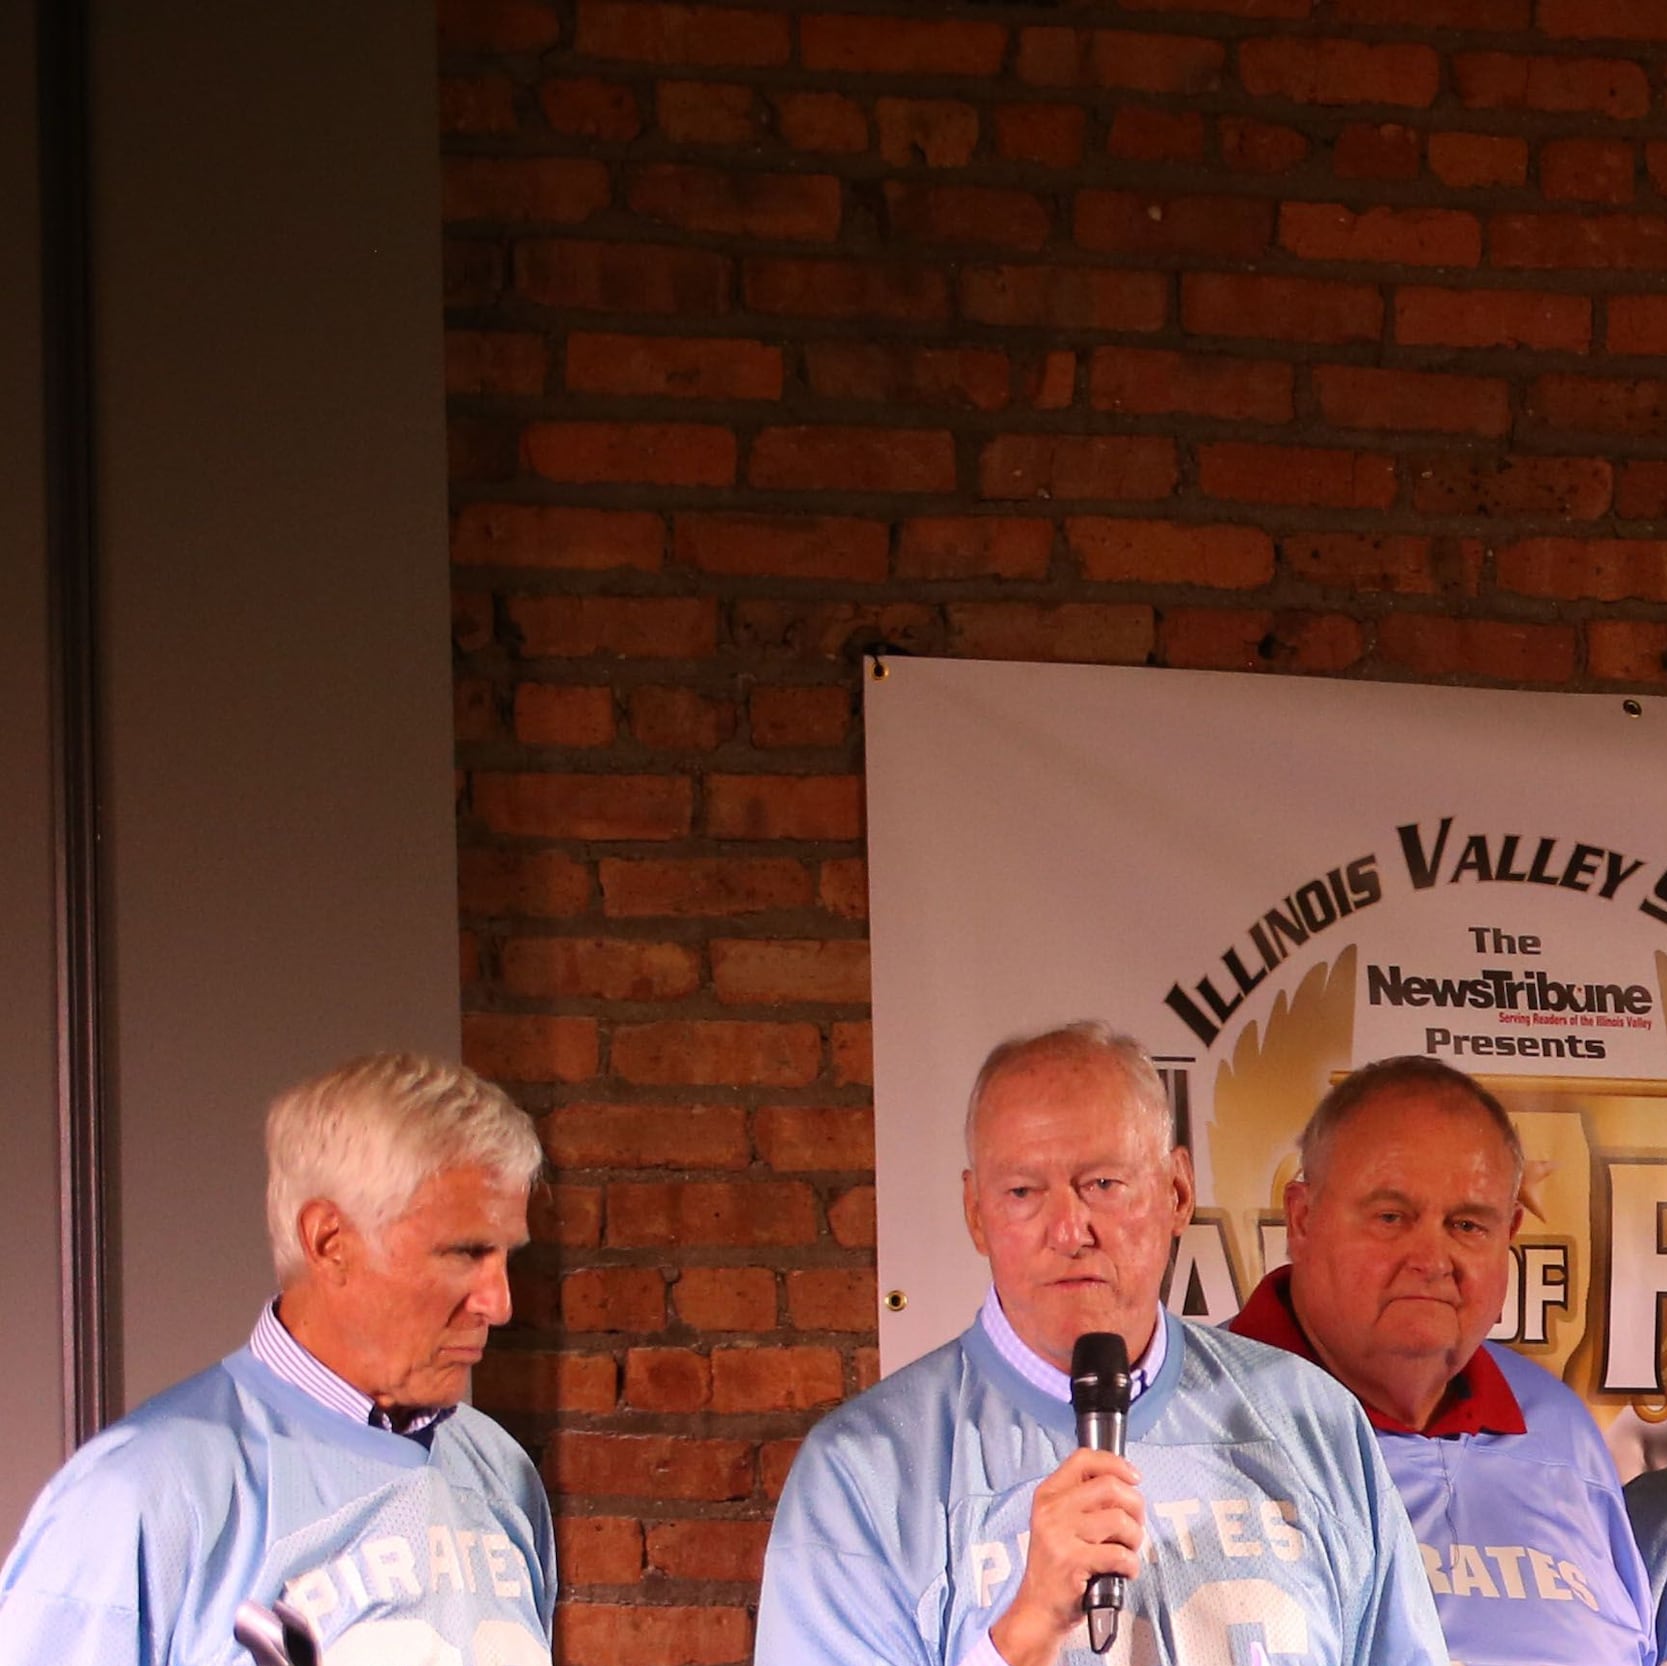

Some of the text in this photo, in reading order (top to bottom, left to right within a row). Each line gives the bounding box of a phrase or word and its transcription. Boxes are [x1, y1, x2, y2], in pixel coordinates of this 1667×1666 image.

[1164, 853, 1383, 1048] ILLINOIS
[1396, 817, 1644, 901] VALLEY
[1468, 926, 1542, 955] The
[1366, 965, 1653, 1015] NewsTribune
[1498, 1012, 1653, 1030] Serving Readers of the Illinois Valley
[1425, 1027, 1607, 1060] Presents
